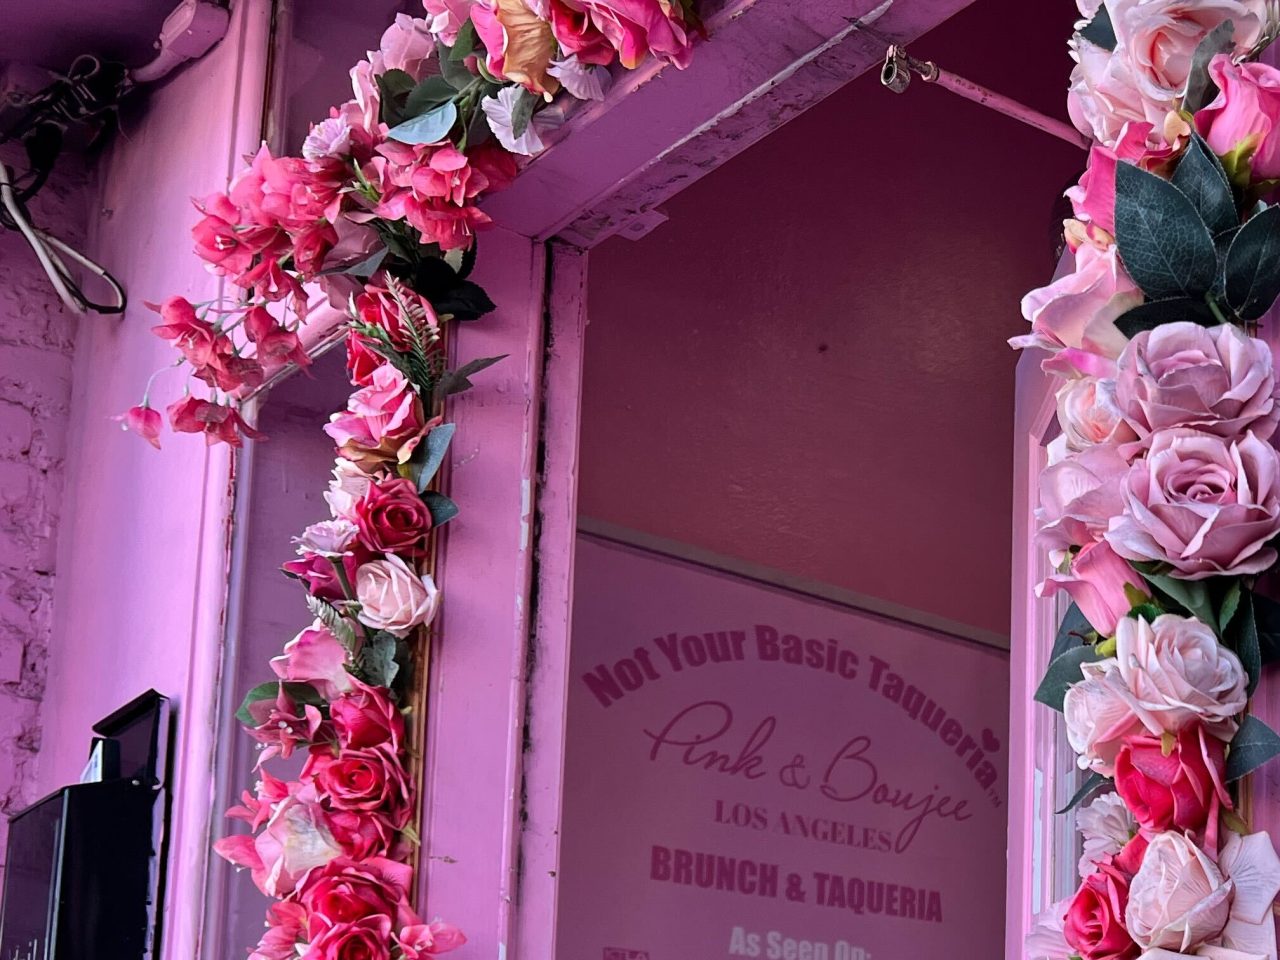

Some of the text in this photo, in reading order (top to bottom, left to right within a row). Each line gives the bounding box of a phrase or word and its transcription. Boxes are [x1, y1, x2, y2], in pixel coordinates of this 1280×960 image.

[582, 645, 661, 708] Not
[654, 630, 746, 673] Your
[754, 624, 860, 680] Basic
[869, 655, 1000, 790] Taqueria
[643, 700, 973, 853] Pink & Boujee
[714, 800, 893, 853] LOS ANGELES
[650, 845, 943, 923] BRUNCH & TAQUERIA
[728, 926, 760, 958] As
